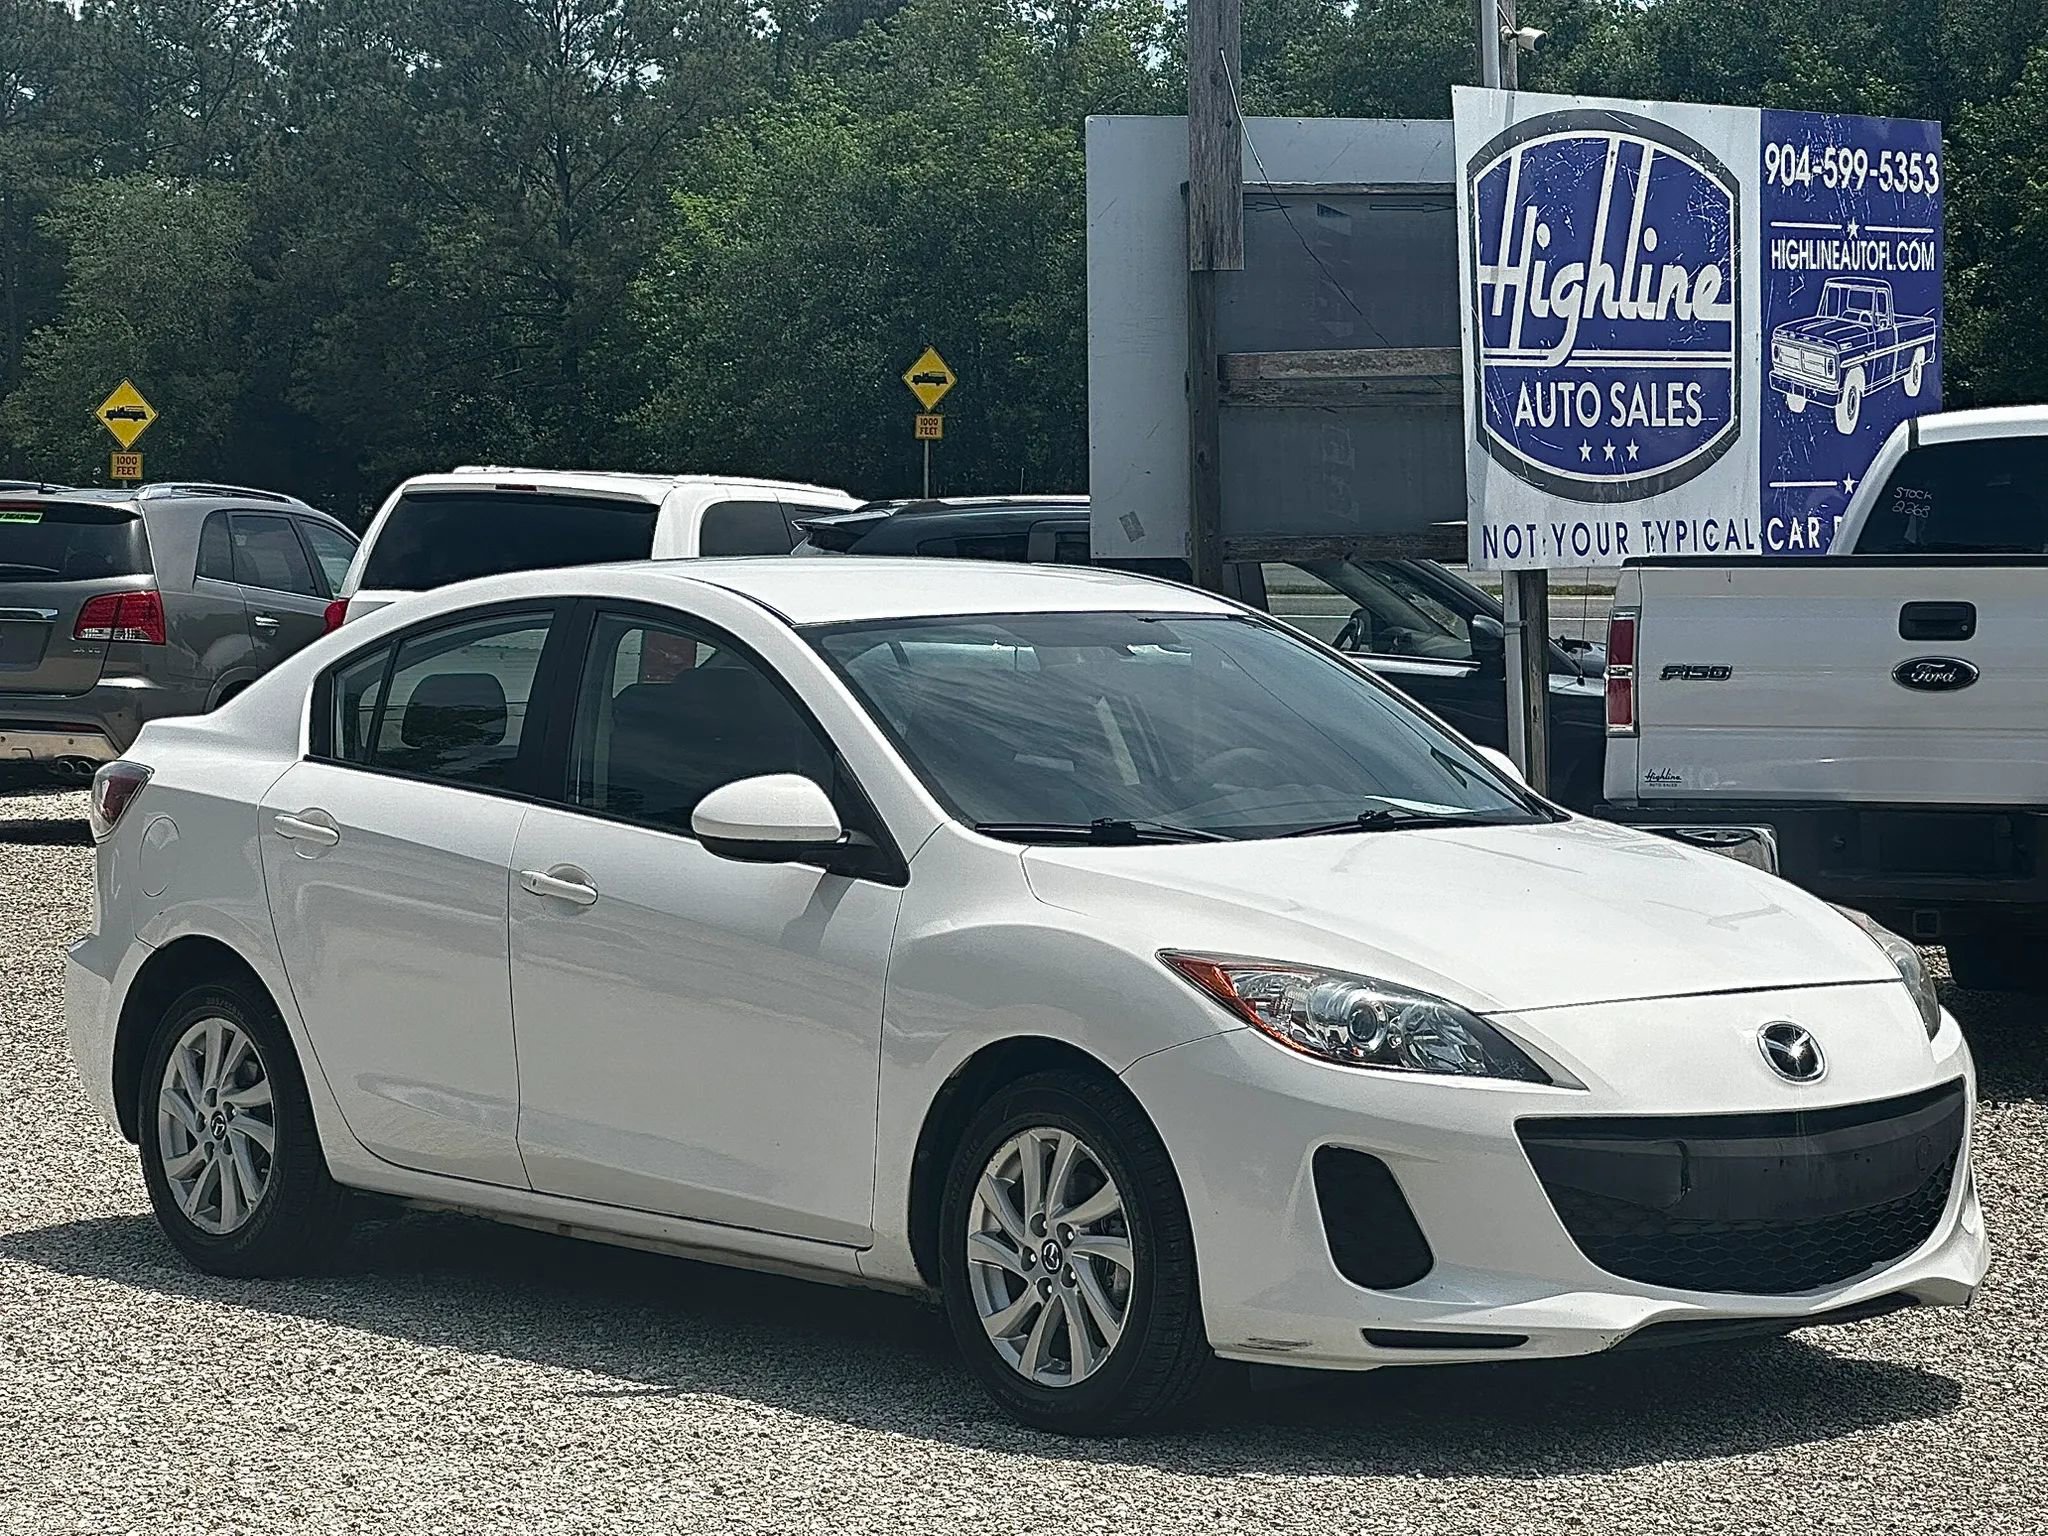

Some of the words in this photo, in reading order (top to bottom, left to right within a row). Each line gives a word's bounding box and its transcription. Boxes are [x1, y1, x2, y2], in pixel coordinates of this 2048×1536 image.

[1764, 142, 1940, 194] 904-599-5353
[1479, 137, 1732, 366] Highline
[1771, 238, 1935, 271] HIGHLINEAUTOFL.COM
[1514, 381, 1601, 427] AUTO
[1610, 381, 1701, 427] SALES
[919, 417, 939, 426] 1000
[919, 427, 939, 436] FEET
[116, 455, 138, 465] 1000
[116, 466, 137, 476] FEET
[1893, 486, 1933, 500] STOCK
[1482, 523, 1536, 559] NOT
[1551, 521, 1628, 556] YOUR
[1641, 518, 1755, 554] TYPICAL
[1767, 516, 1820, 550] CAR
[1910, 662, 1957, 682] Ford
[1644, 767, 1682, 782] Highline
